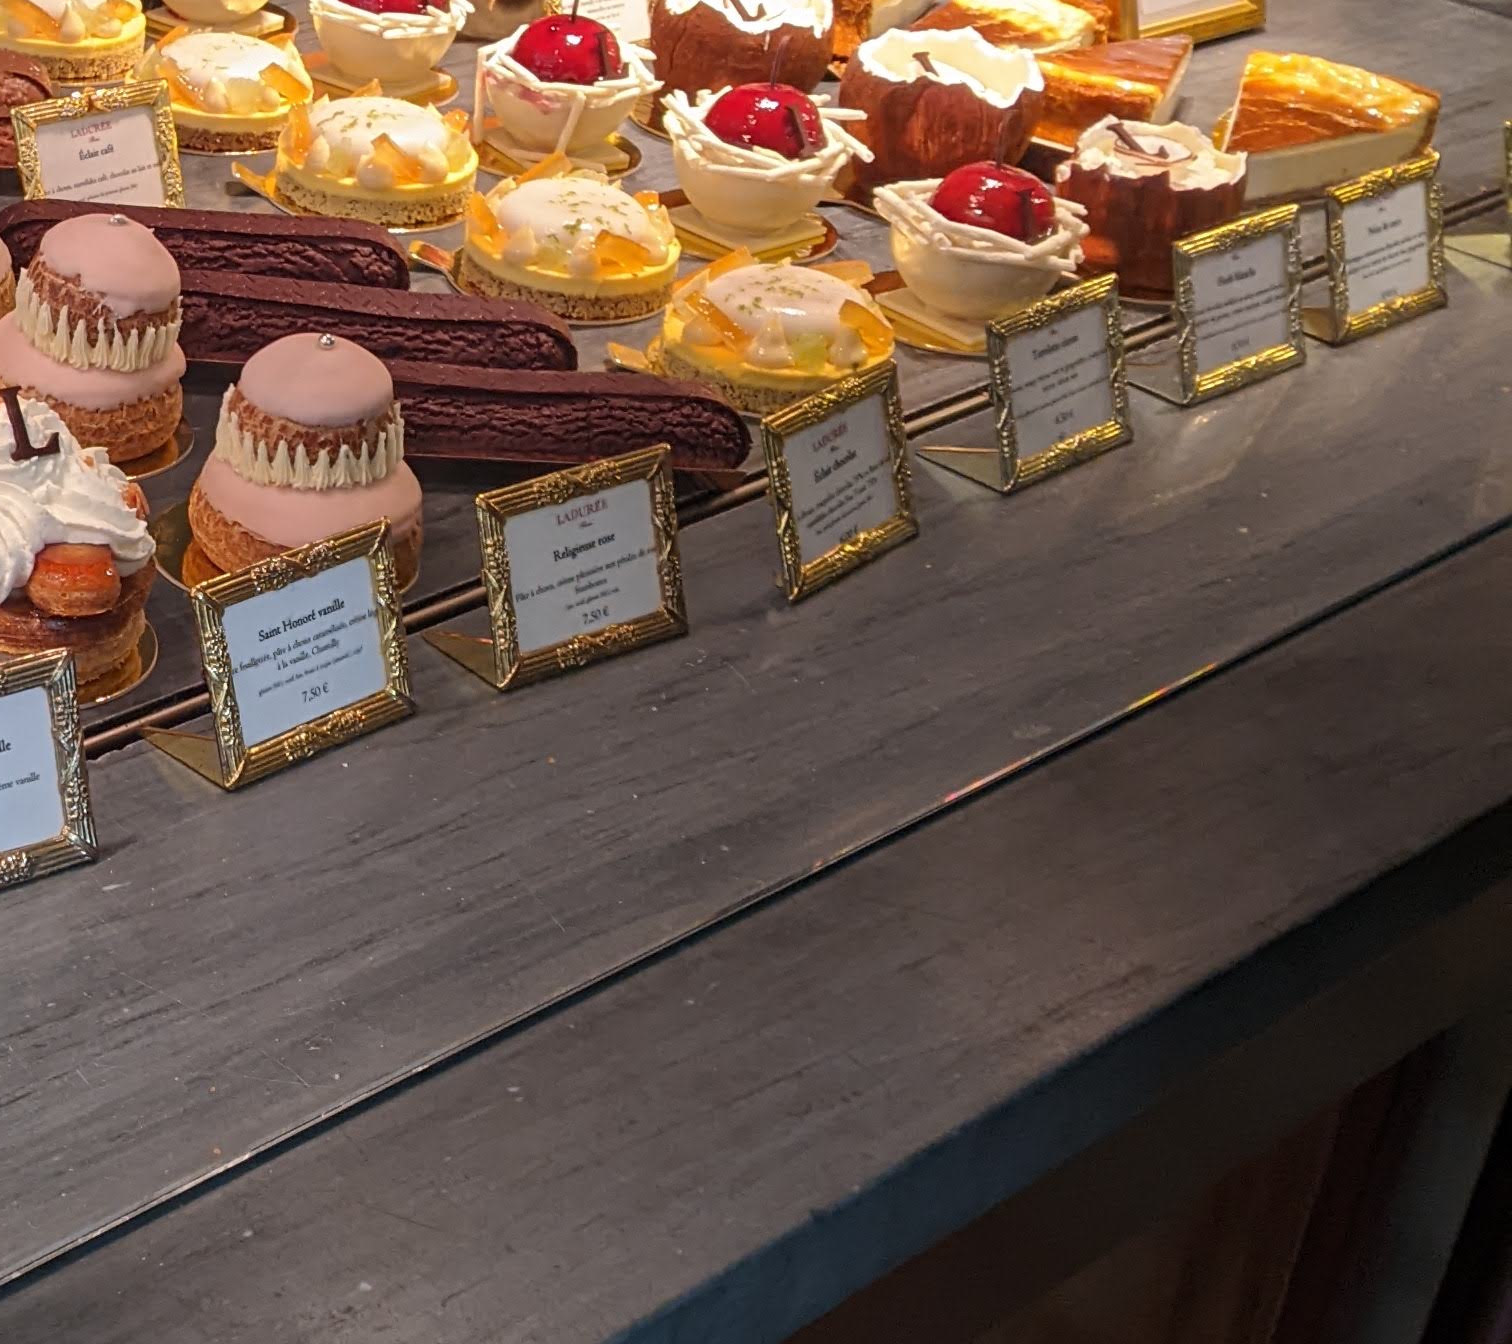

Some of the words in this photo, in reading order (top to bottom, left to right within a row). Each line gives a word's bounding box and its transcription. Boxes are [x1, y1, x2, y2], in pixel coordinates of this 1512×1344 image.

[598, 534, 615, 545] rose
[259, 627, 281, 642] Saint
[282, 610, 316, 632] Honoré
[318, 599, 344, 617] vanille
[302, 686, 321, 702] 7,50
[323, 682, 328, 693] €
[16, 772, 40, 785] vanille
